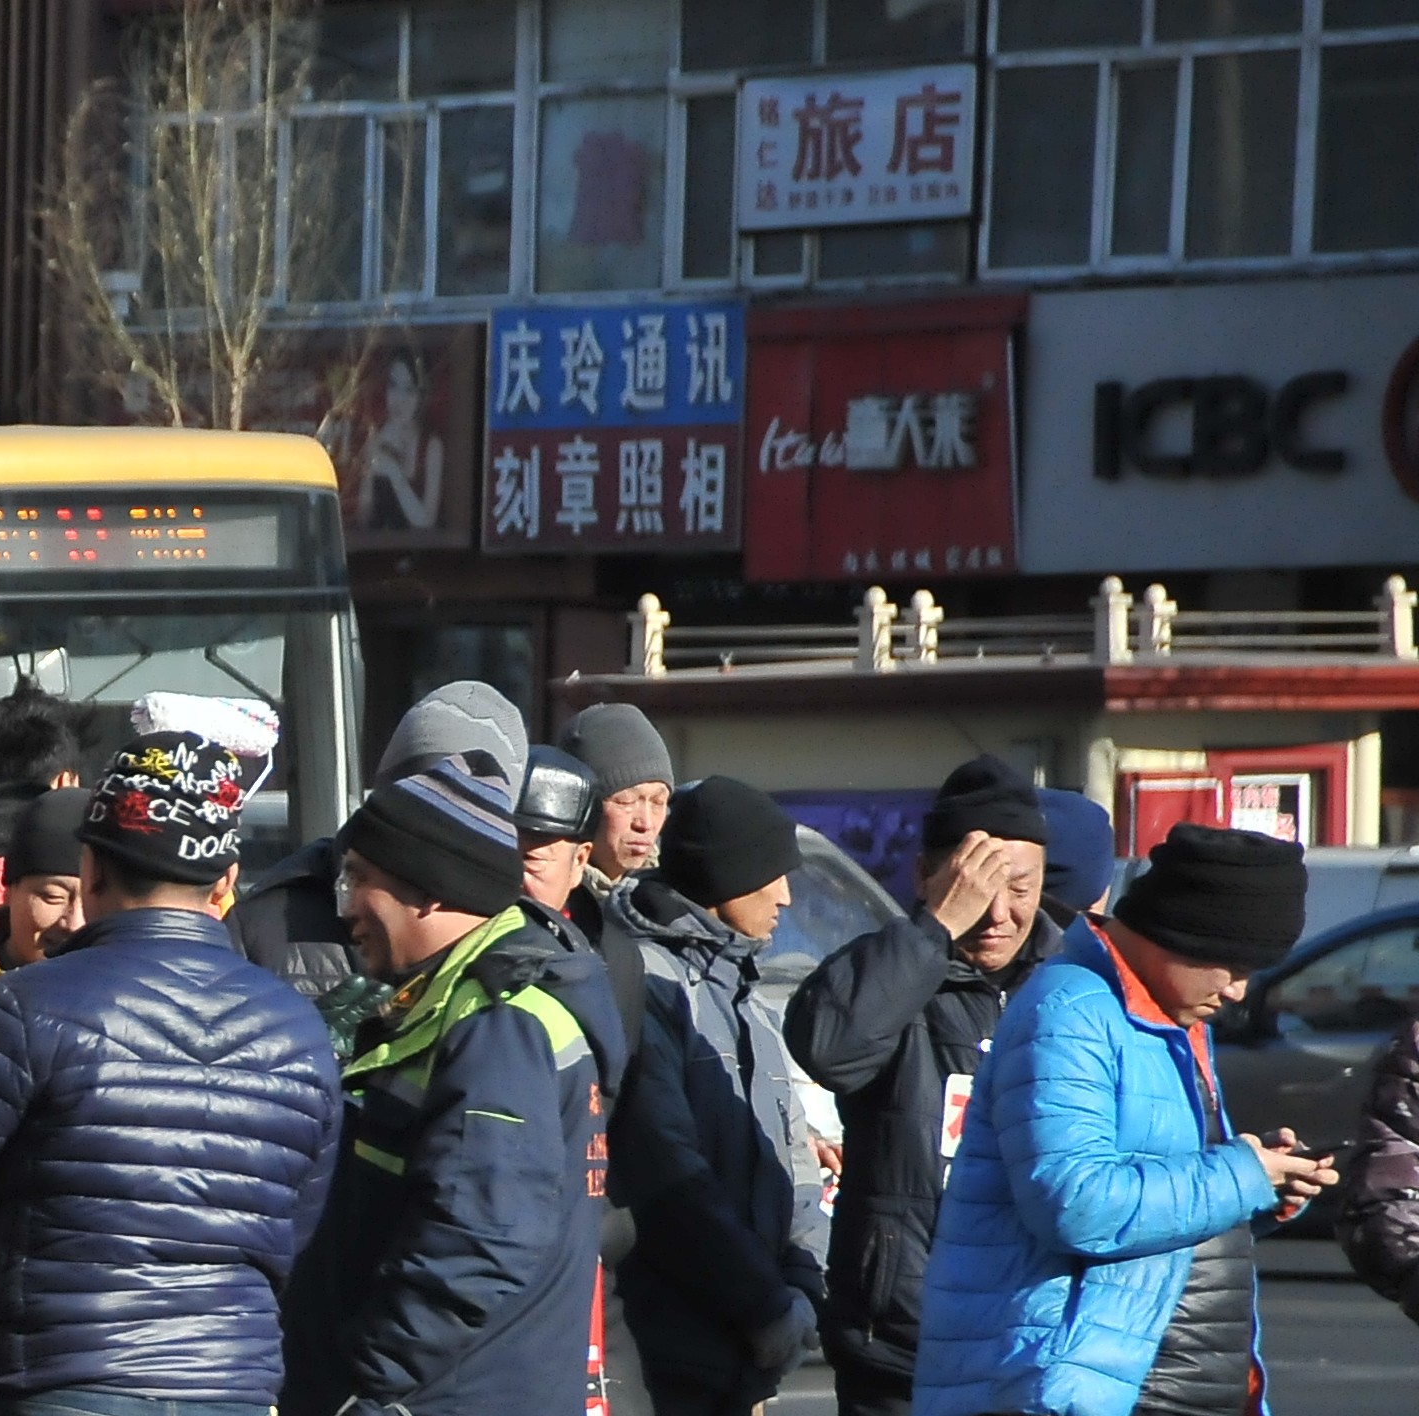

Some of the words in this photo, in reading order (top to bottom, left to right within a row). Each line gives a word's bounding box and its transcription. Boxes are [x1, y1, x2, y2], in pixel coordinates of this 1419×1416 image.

[791, 81, 962, 182] 旅店
[497, 312, 733, 415] 庆玲通讯
[1093, 369, 1349, 483] ICBC
[493, 434, 725, 539] 刻章照相
